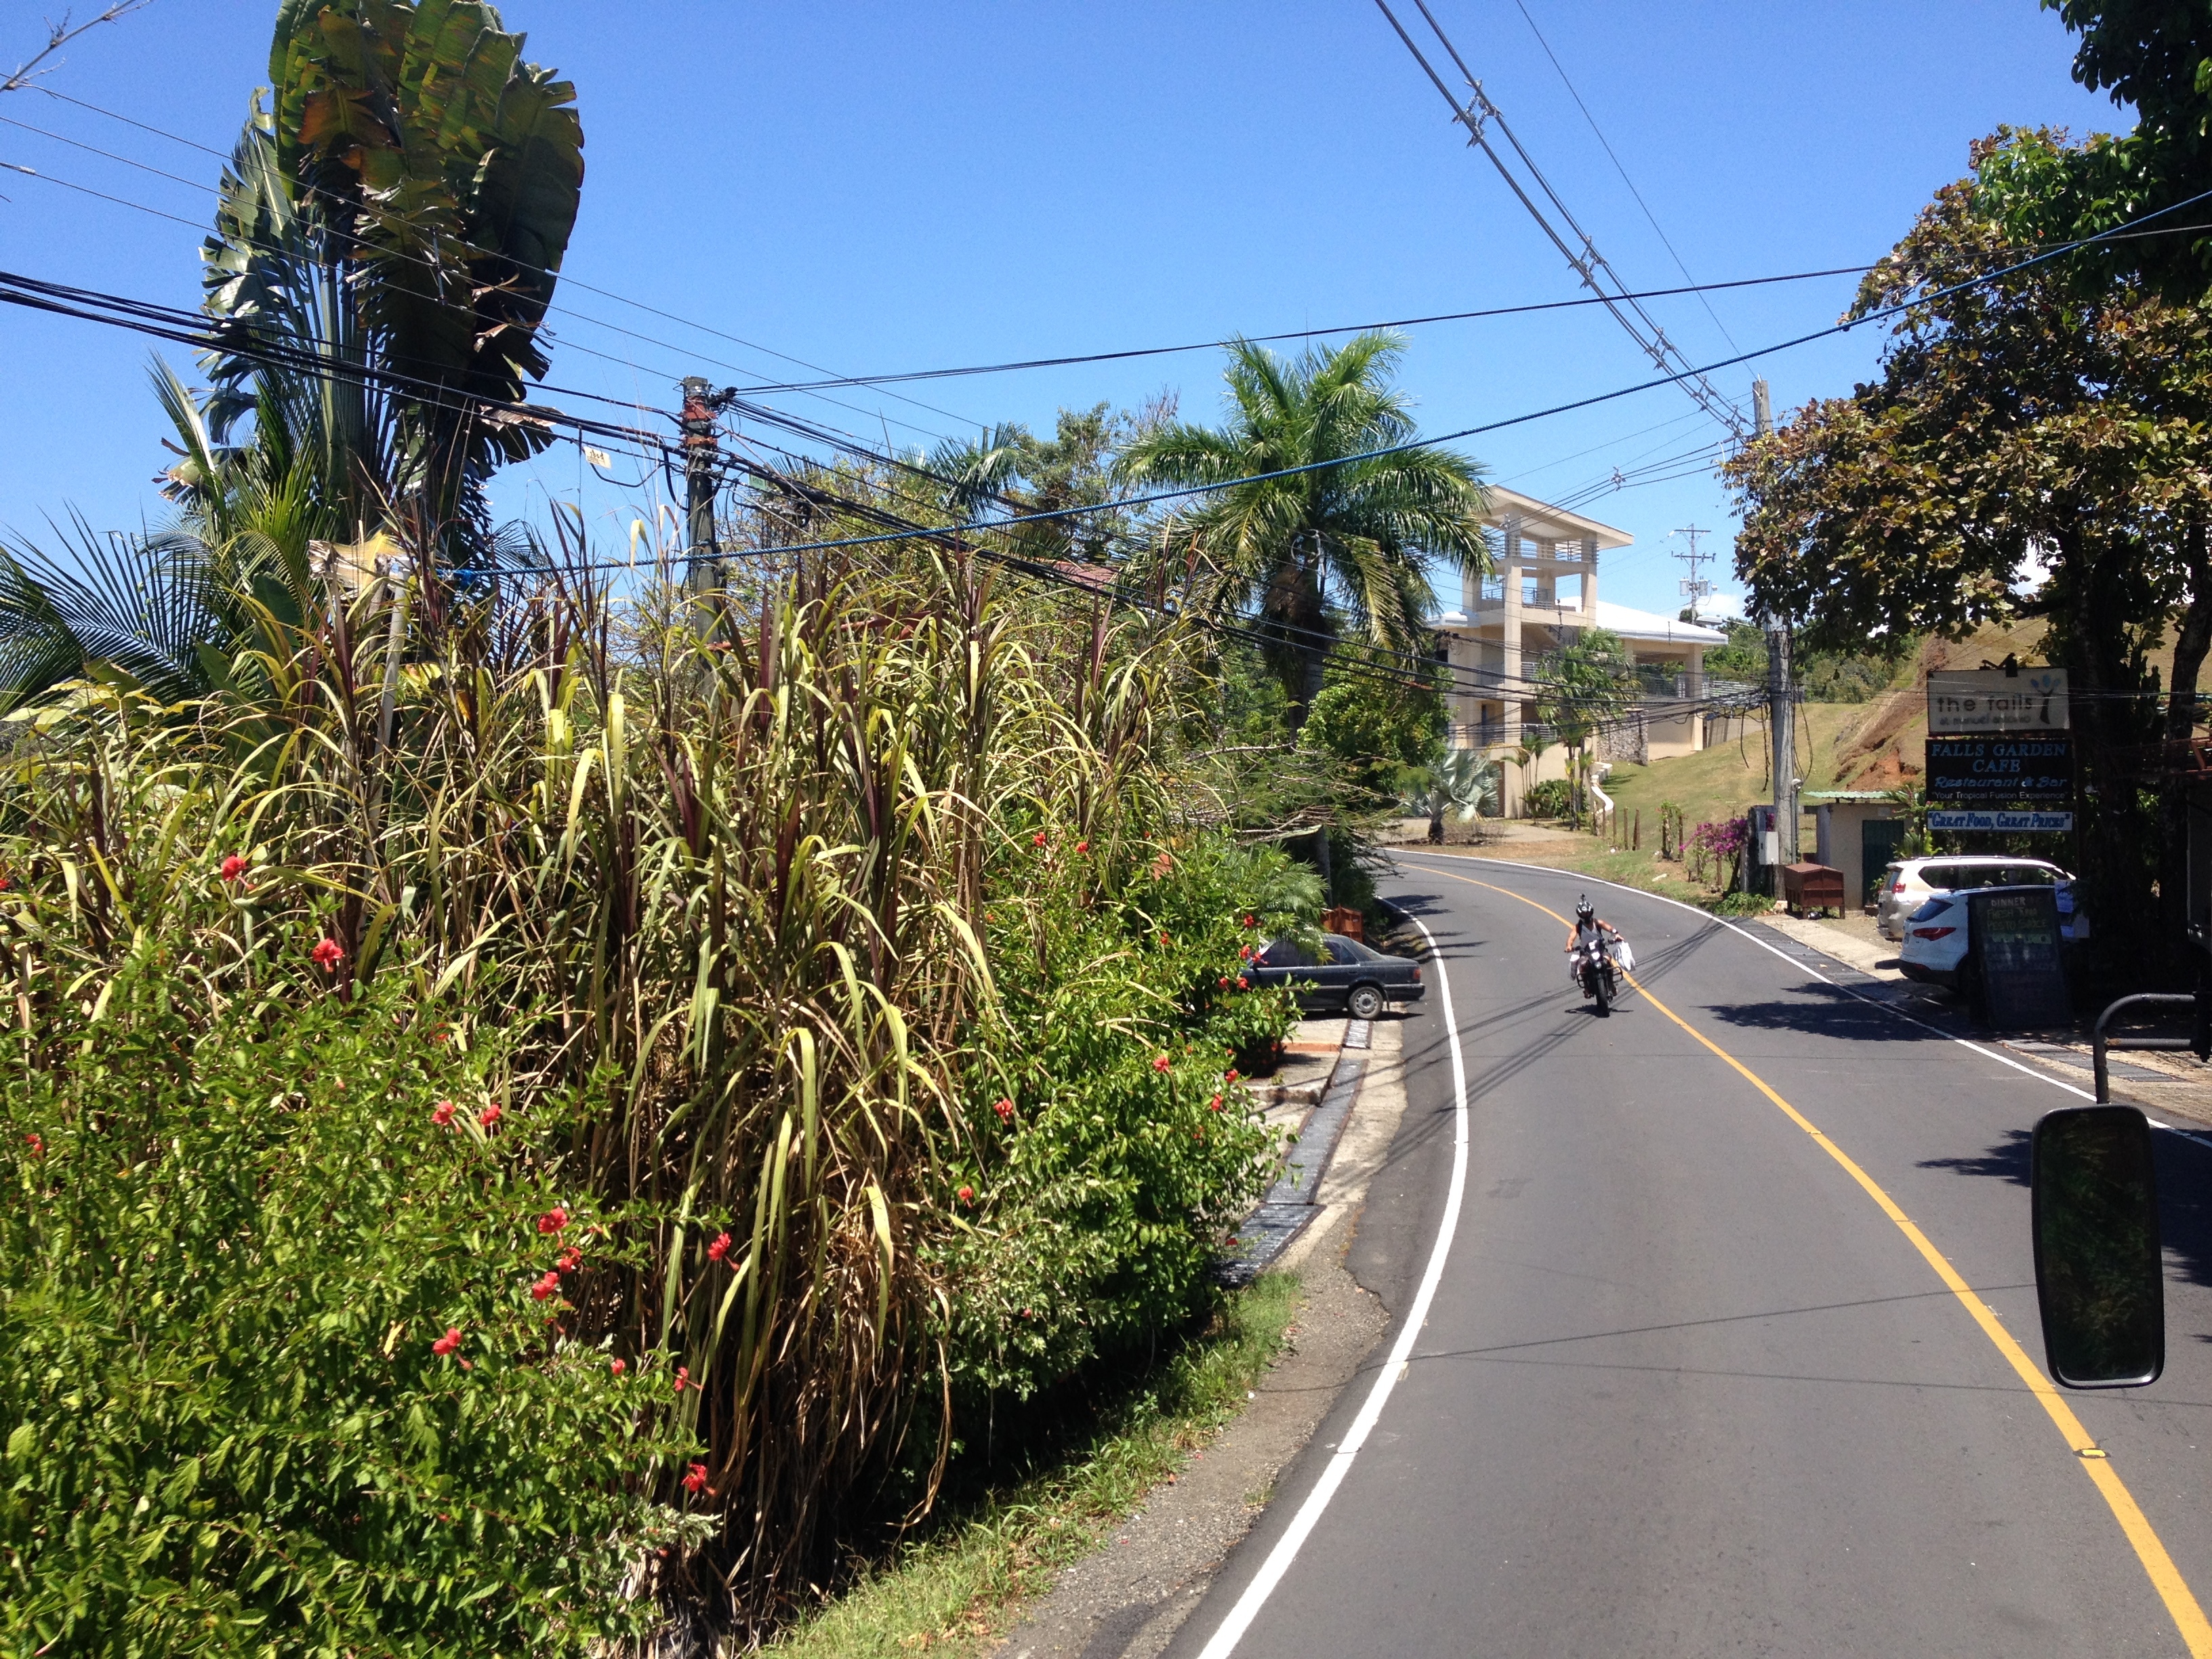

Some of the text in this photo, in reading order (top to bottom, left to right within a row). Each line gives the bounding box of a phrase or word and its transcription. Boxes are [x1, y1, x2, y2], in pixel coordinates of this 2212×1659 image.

[1937, 693, 2032, 712] the falls
[1931, 743, 2067, 756] FALLS GARDEN
[1972, 759, 2021, 773] CAFE
[1934, 776, 2068, 788] Restaurant & Bar
[1956, 792, 1988, 800] Tropical
[1991, 897, 2026, 907] DINNER
